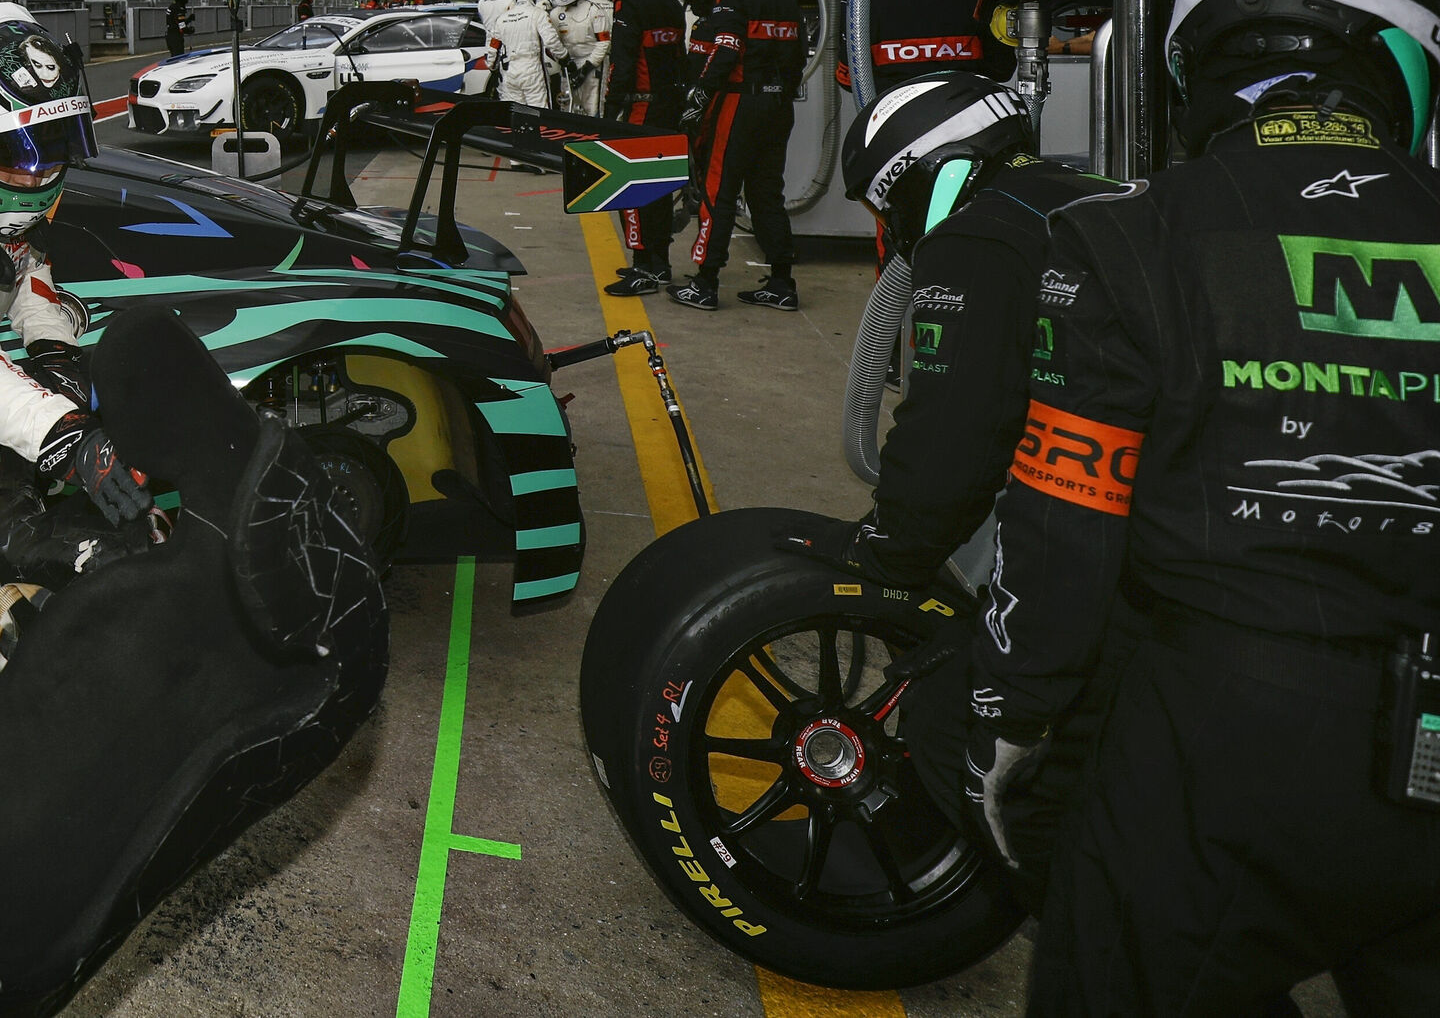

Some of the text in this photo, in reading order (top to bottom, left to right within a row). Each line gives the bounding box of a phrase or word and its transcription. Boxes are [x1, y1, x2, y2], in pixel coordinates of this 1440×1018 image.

[880, 42, 972, 61] TOTAL
[36, 101, 69, 119] Audi
[878, 85, 915, 113] Audi Sport
[881, 88, 920, 117] Team Land
[874, 150, 919, 199] uvex
[692, 218, 710, 262] TOTAL
[932, 290, 964, 302] Land
[1280, 416, 1313, 440] by
[883, 588, 955, 617] DHD2 P
[662, 681, 685, 703] RL
[656, 714, 672, 726] 4
[821, 718, 841, 729] REAR
[653, 727, 670, 752] Set
[795, 745, 806, 769] REAR
[840, 768, 860, 785] REAR
[712, 839, 733, 864] #29
[652, 792, 767, 937] PIRELLI
